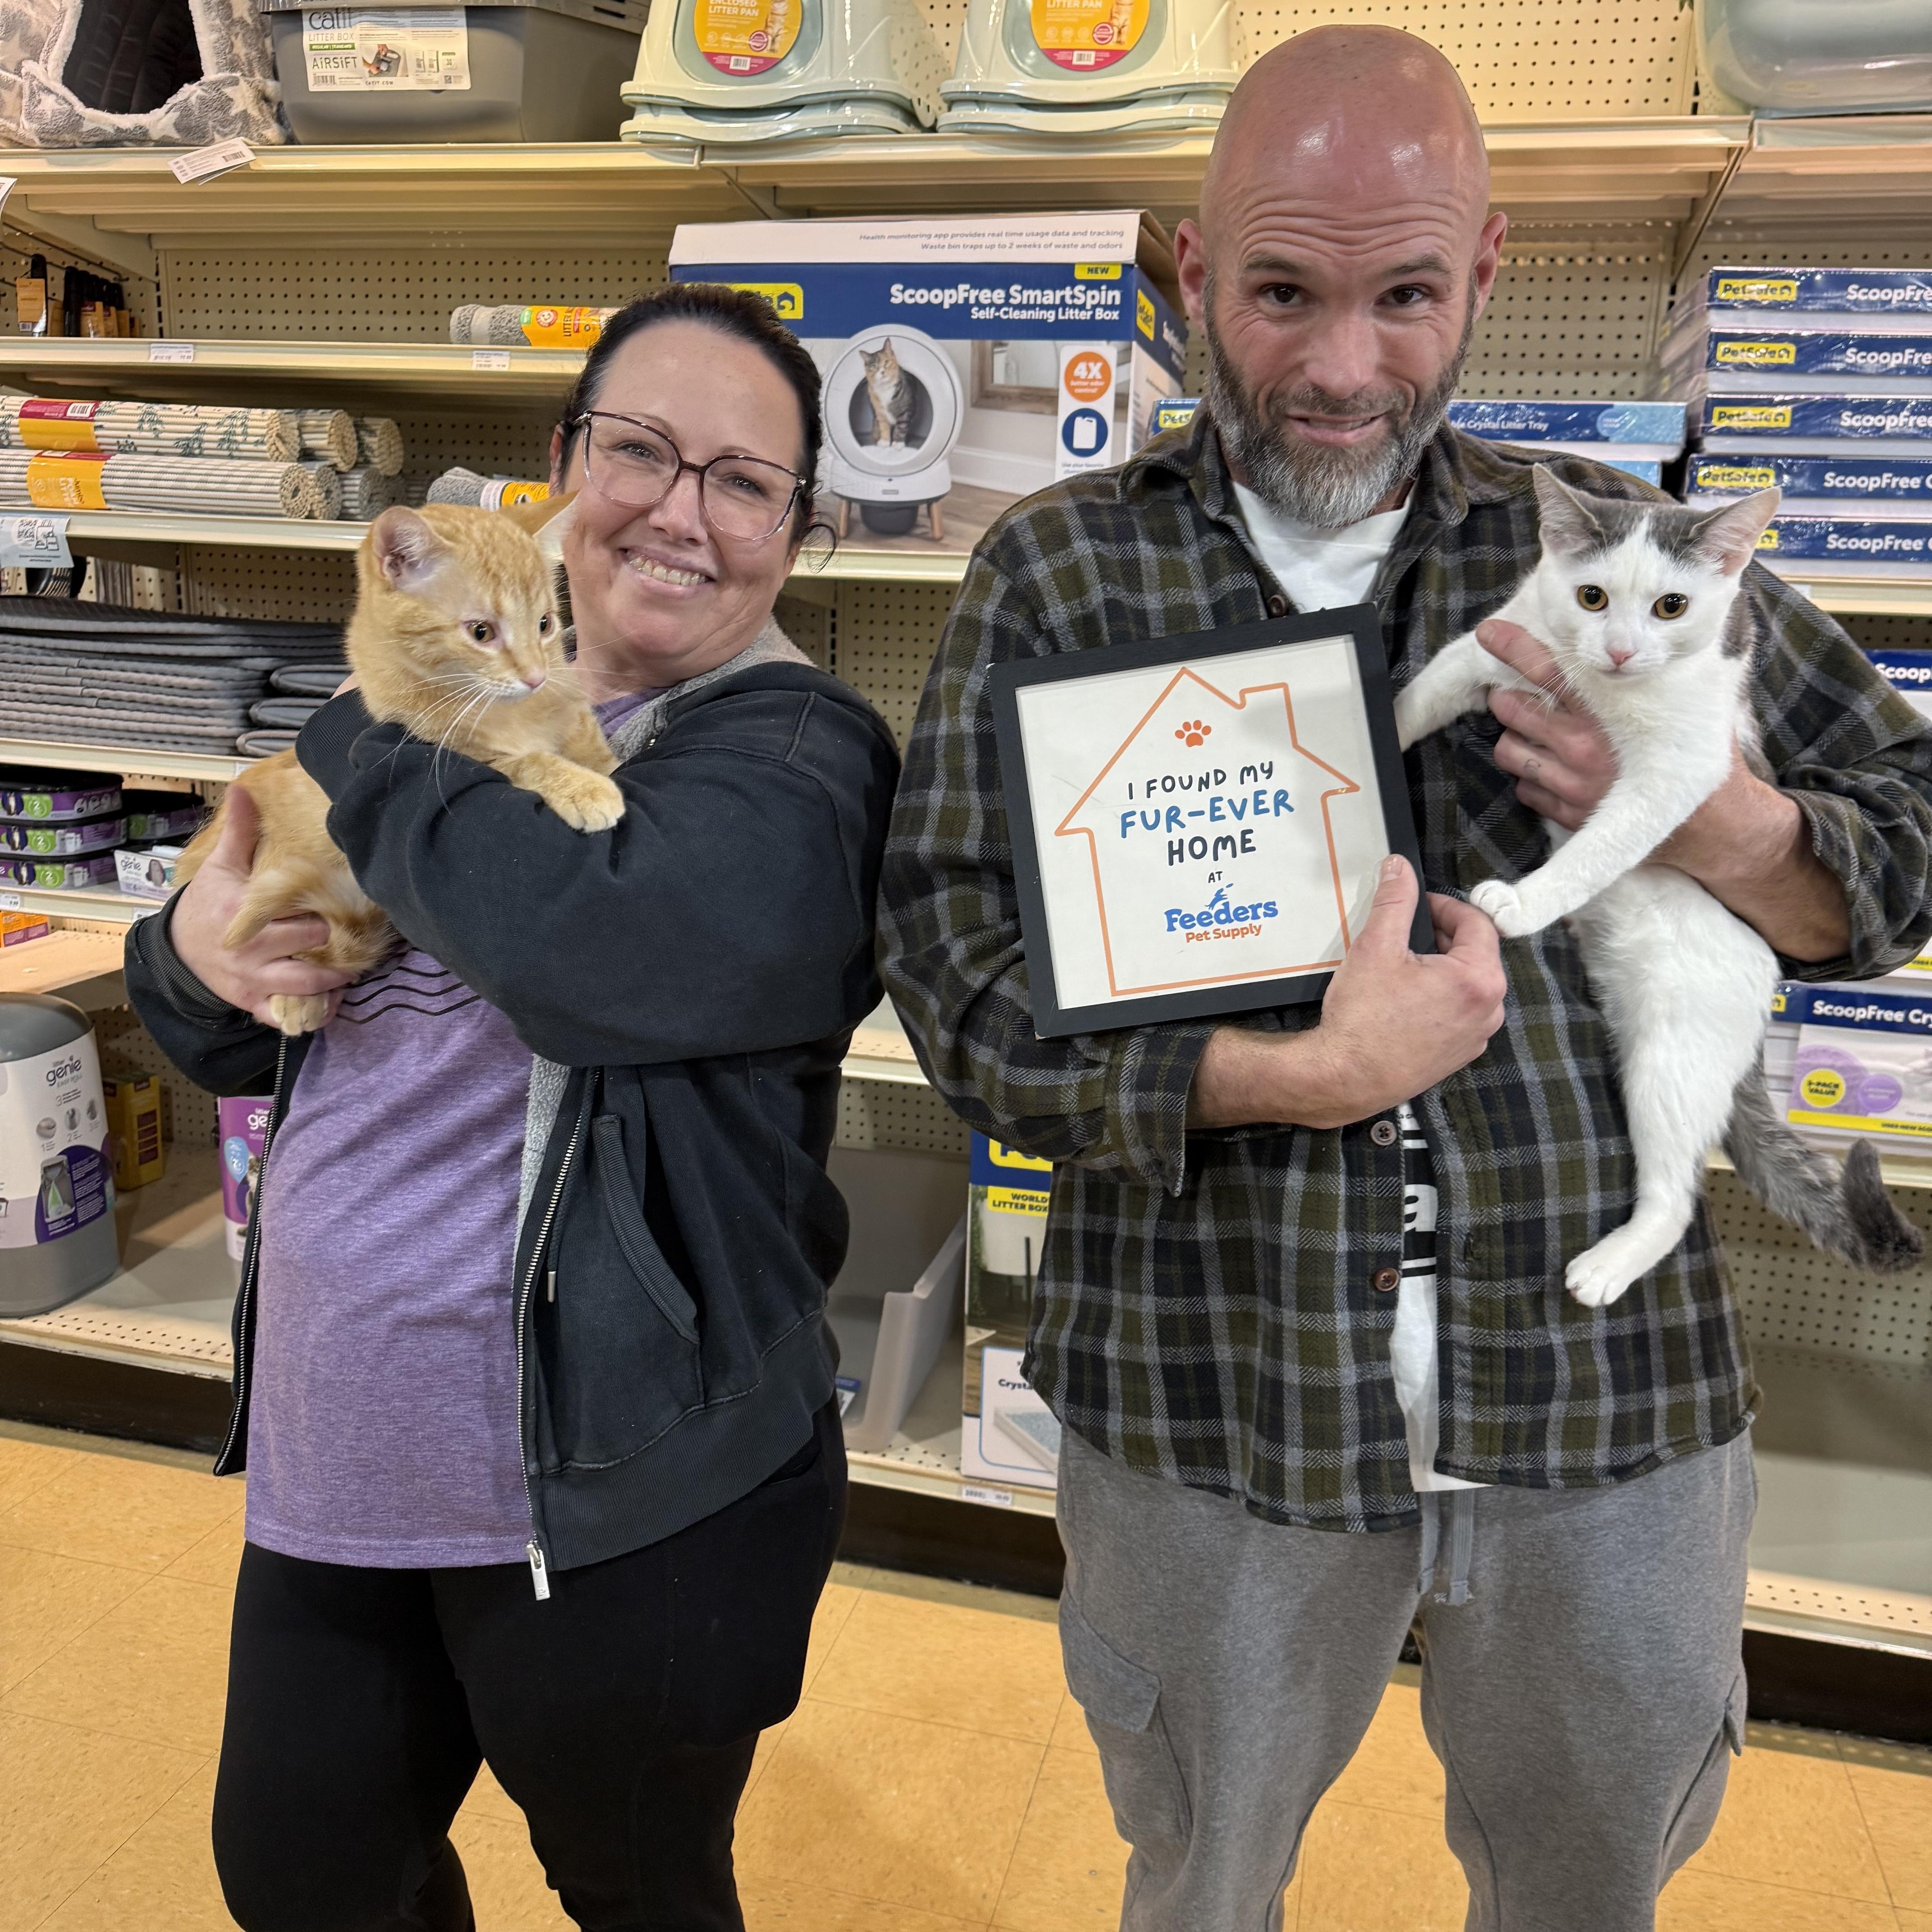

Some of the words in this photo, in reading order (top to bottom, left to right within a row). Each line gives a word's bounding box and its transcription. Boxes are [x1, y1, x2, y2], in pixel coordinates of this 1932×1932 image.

[708, 6, 737, 14] LITTER
[740, 8, 759, 16] PAN
[308, 32, 335, 41] LITTER
[890, 284, 1006, 309] ScoopFree
[1009, 285, 1121, 309] SmartSpin
[971, 307, 1056, 322] Self-Cleaning
[1058, 307, 1093, 320] Litter
[1095, 308, 1120, 320] Box
[563, 315, 572, 337] LITTER
[1073, 361, 1103, 379] 4X
[1501, 419, 1526, 430] Litter
[1528, 420, 1549, 432] Tray
[1823, 471, 1922, 492] ScoopFree
[1826, 533, 1923, 553] ScoopFree
[1875, 662, 1932, 683] Scoop
[1127, 782, 1133, 800] I
[1145, 768, 1227, 799] FOUND
[1239, 760, 1274, 785] MY
[1120, 789, 1295, 839] FUR-EVER
[1168, 829, 1257, 866] HOME
[1208, 871, 1224, 884] AT
[1164, 900, 1279, 933] Feeders
[1185, 928, 1211, 943] Pet
[1213, 923, 1262, 940] Supply
[1812, 999, 1905, 1022] ScoopFree
[46, 1055, 82, 1086] genie
[993, 1200, 1026, 1210] LITTER
[1011, 1193, 1048, 1203] WORLD
